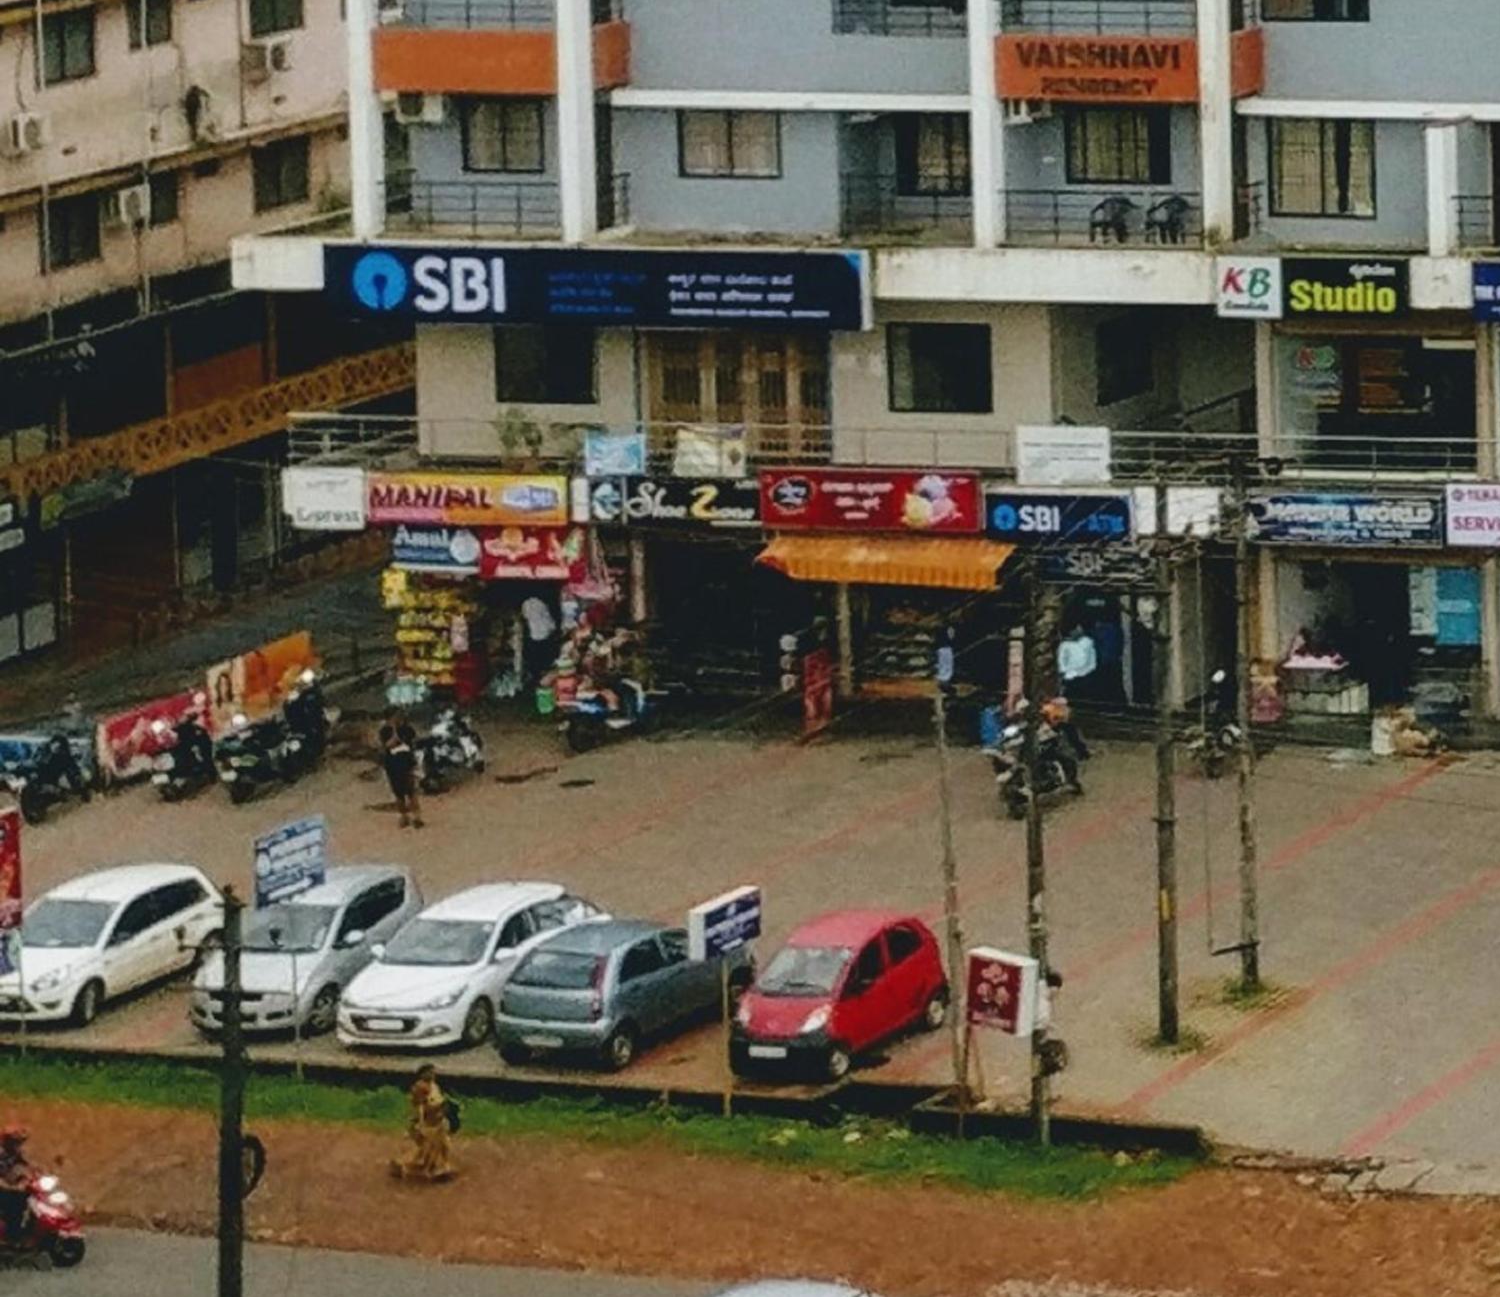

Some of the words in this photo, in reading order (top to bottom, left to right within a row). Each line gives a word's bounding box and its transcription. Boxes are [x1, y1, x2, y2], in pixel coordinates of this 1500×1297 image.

[1015, 41, 1181, 70] VAISHNAVI
[413, 256, 507, 314] SBI
[1222, 266, 1271, 298] KB
[1289, 279, 1397, 313] Studio
[1018, 505, 1061, 532] SBI
